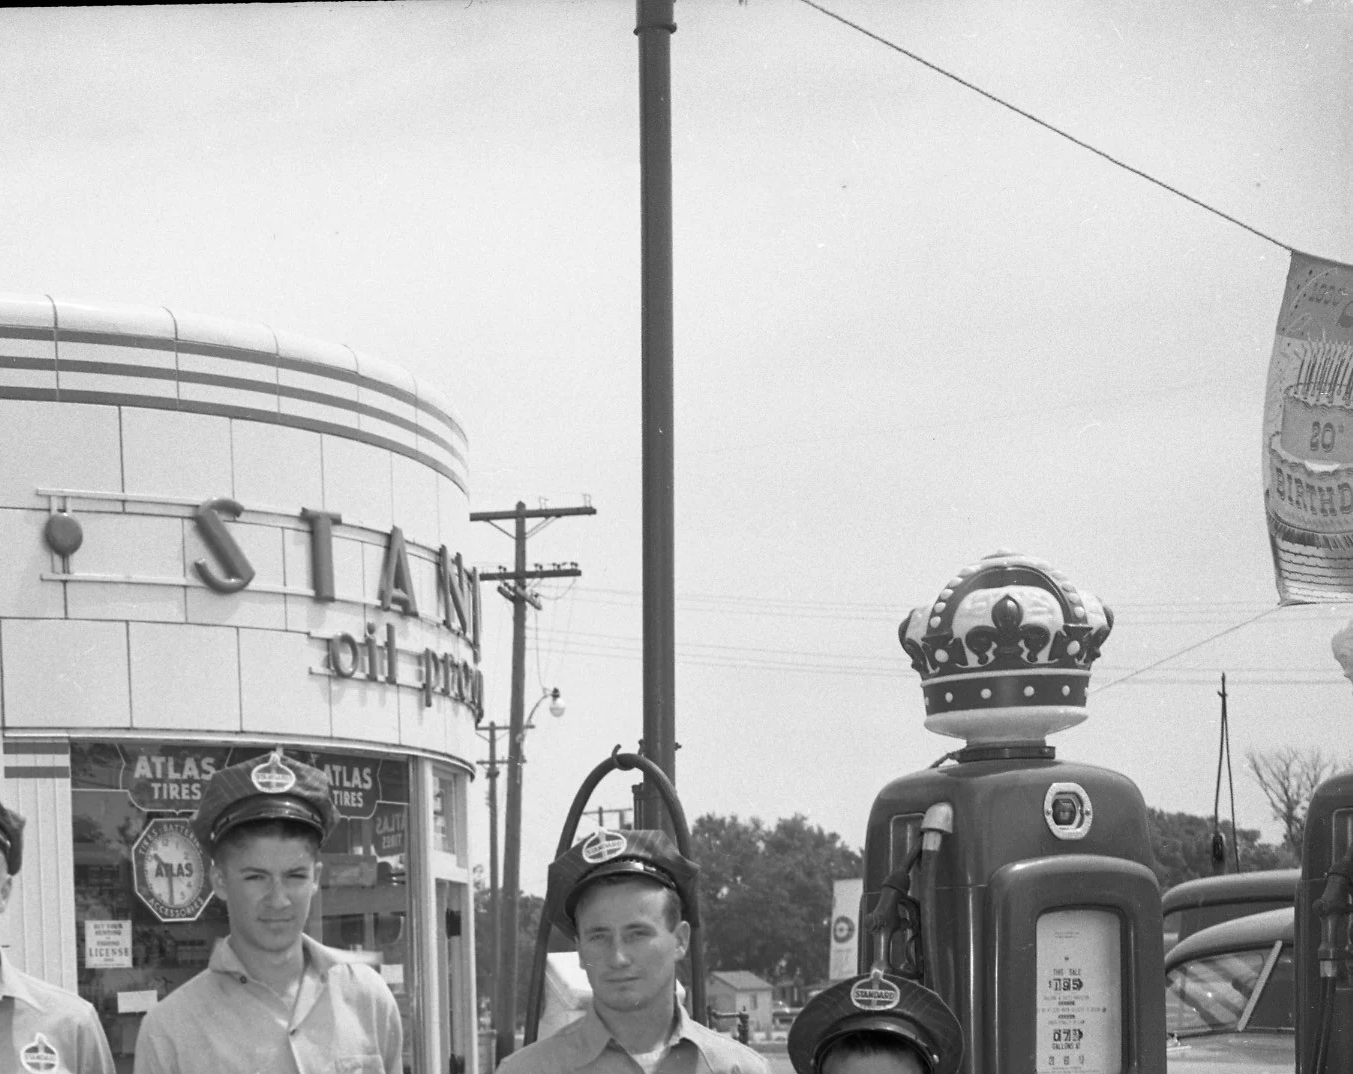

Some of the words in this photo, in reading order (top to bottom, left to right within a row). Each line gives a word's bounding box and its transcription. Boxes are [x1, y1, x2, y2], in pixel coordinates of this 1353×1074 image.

[330, 621, 397, 685] oil
[133, 755, 216, 780] ATLAS
[323, 764, 372, 789] ATLAS
[151, 782, 202, 800] TIRES
[332, 790, 364, 808] TIRES
[155, 862, 193, 878] ATLAS
[88, 947, 129, 957] LICENSE
[855, 990, 896, 999] STANDARD
